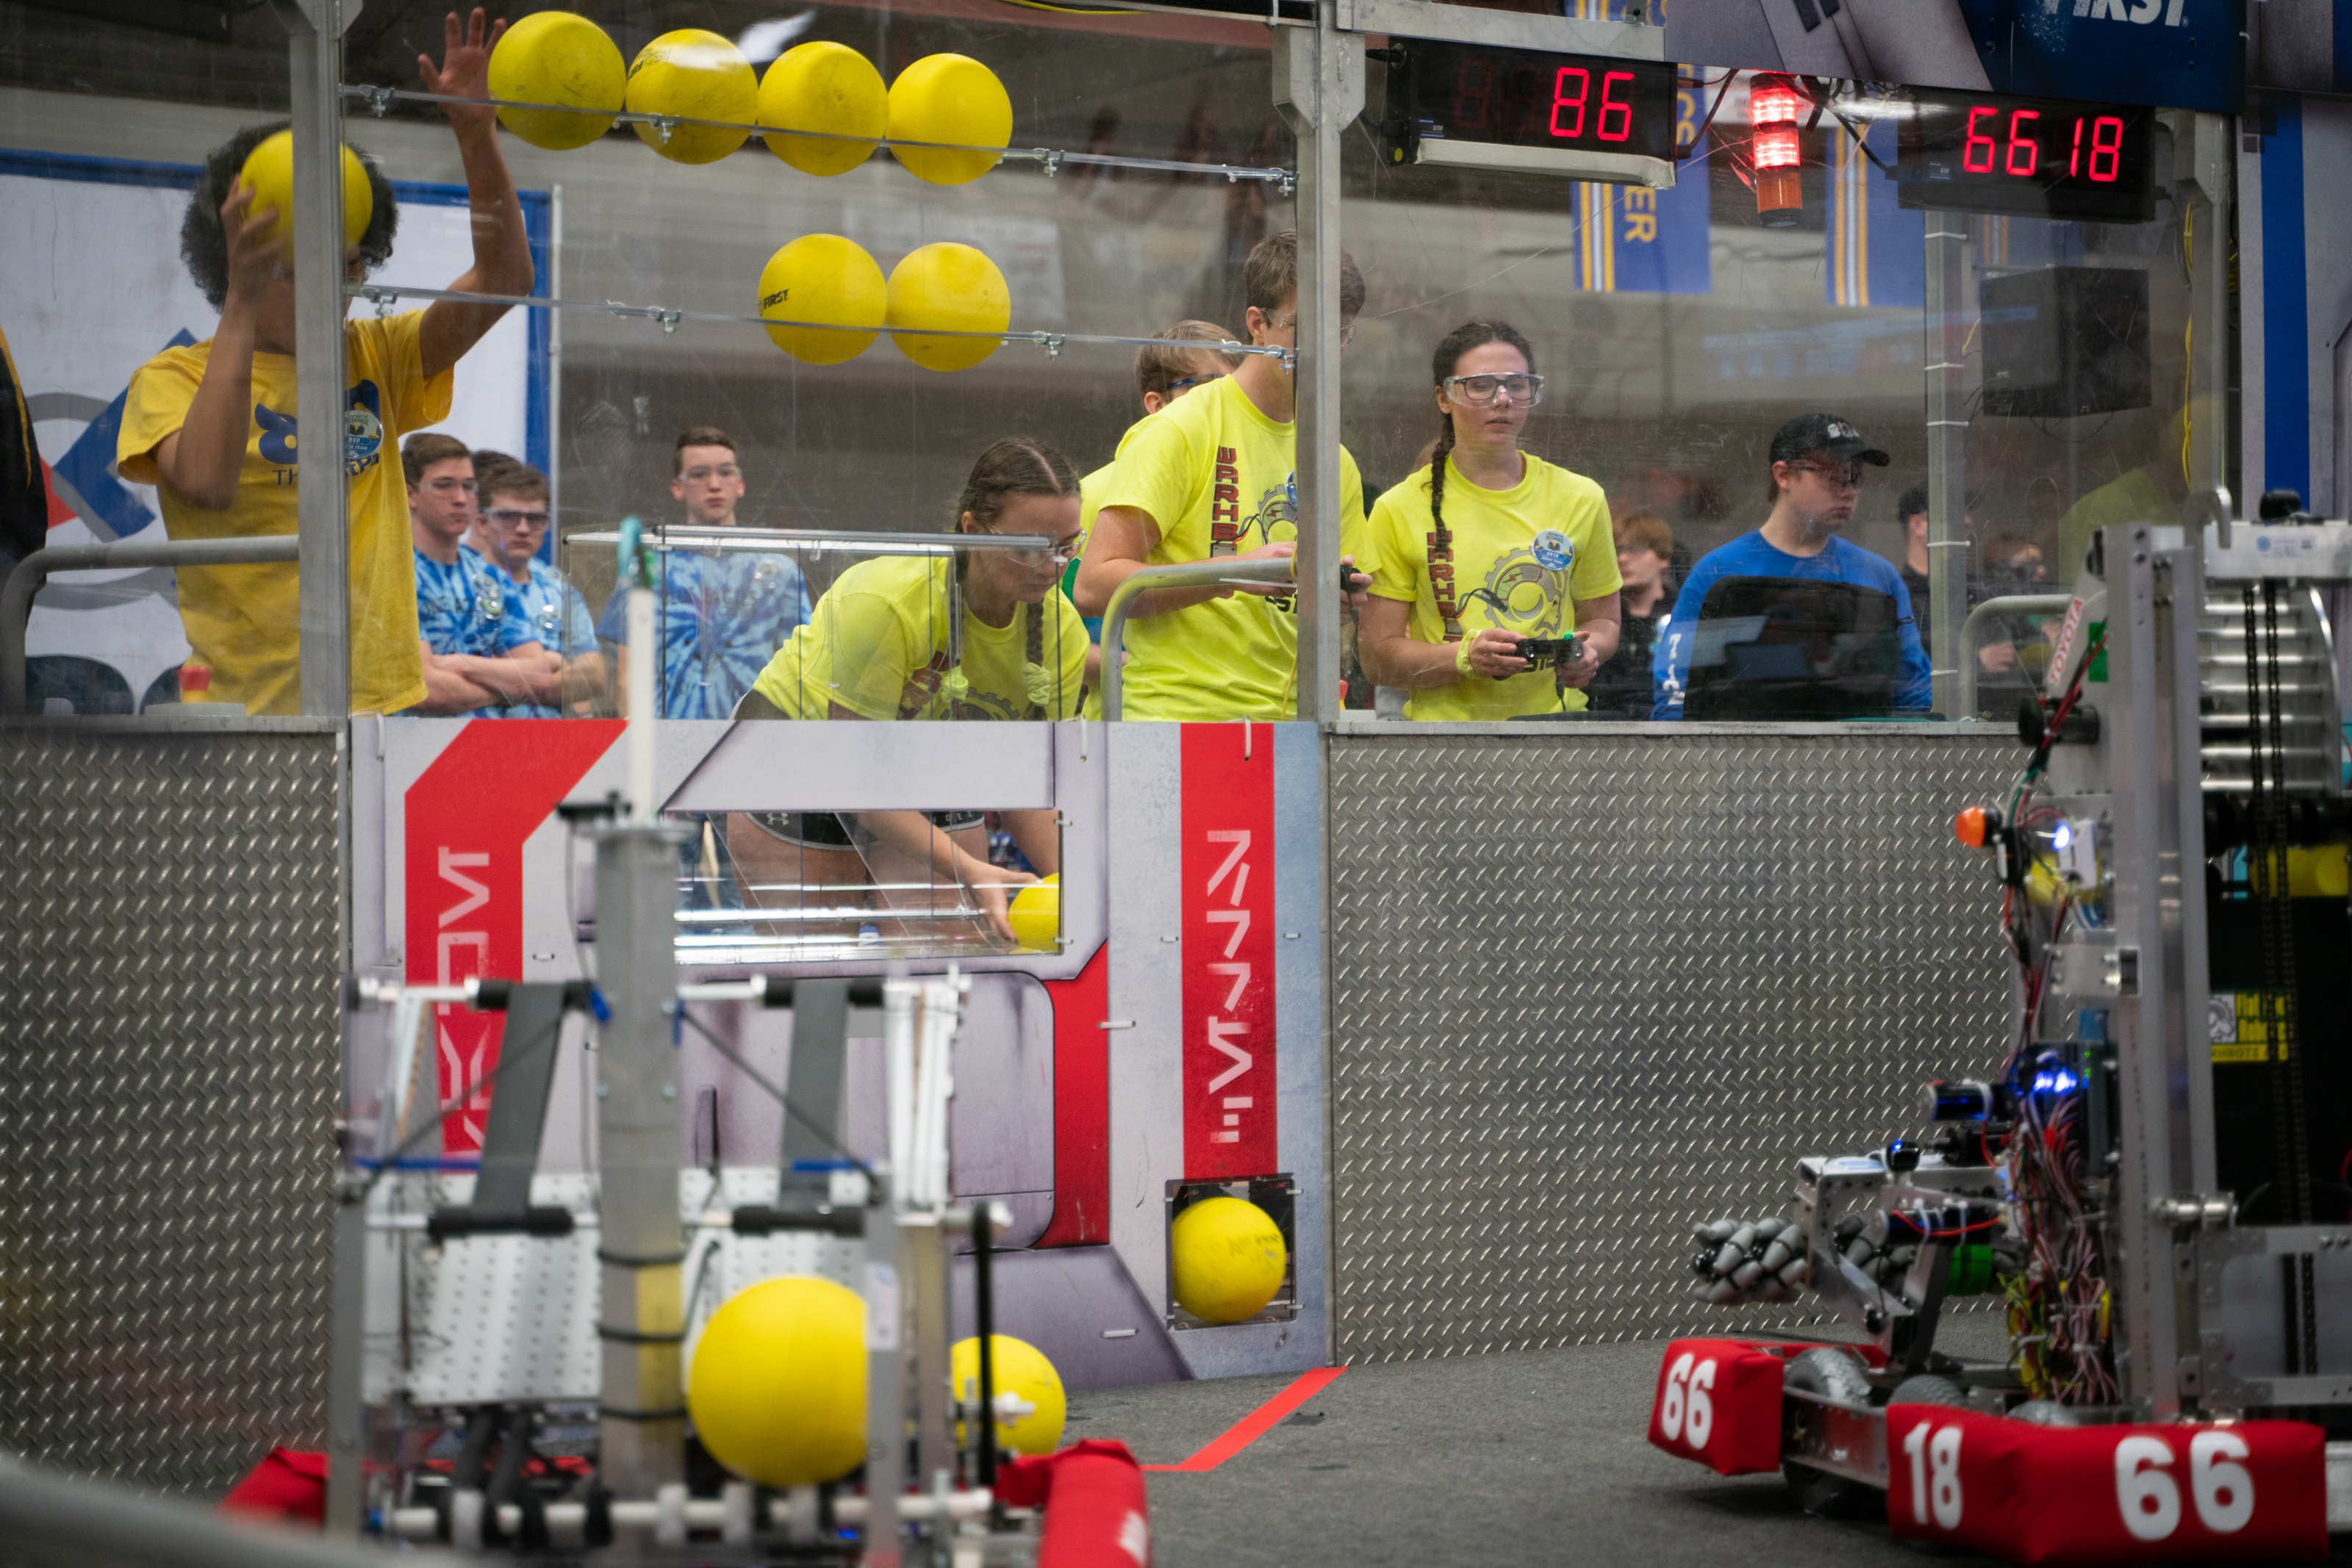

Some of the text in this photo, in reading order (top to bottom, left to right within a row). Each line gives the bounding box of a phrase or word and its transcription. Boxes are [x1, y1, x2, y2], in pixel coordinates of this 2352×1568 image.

[1550, 67, 1635, 142] 86
[764, 289, 790, 309] FIRST
[272, 468, 298, 486] Th
[2048, 599, 2082, 683] TOYOTA
[1660, 1353, 1716, 1450] 66
[1903, 1421, 1963, 1531] 18
[2114, 1430, 2255, 1542] 66
